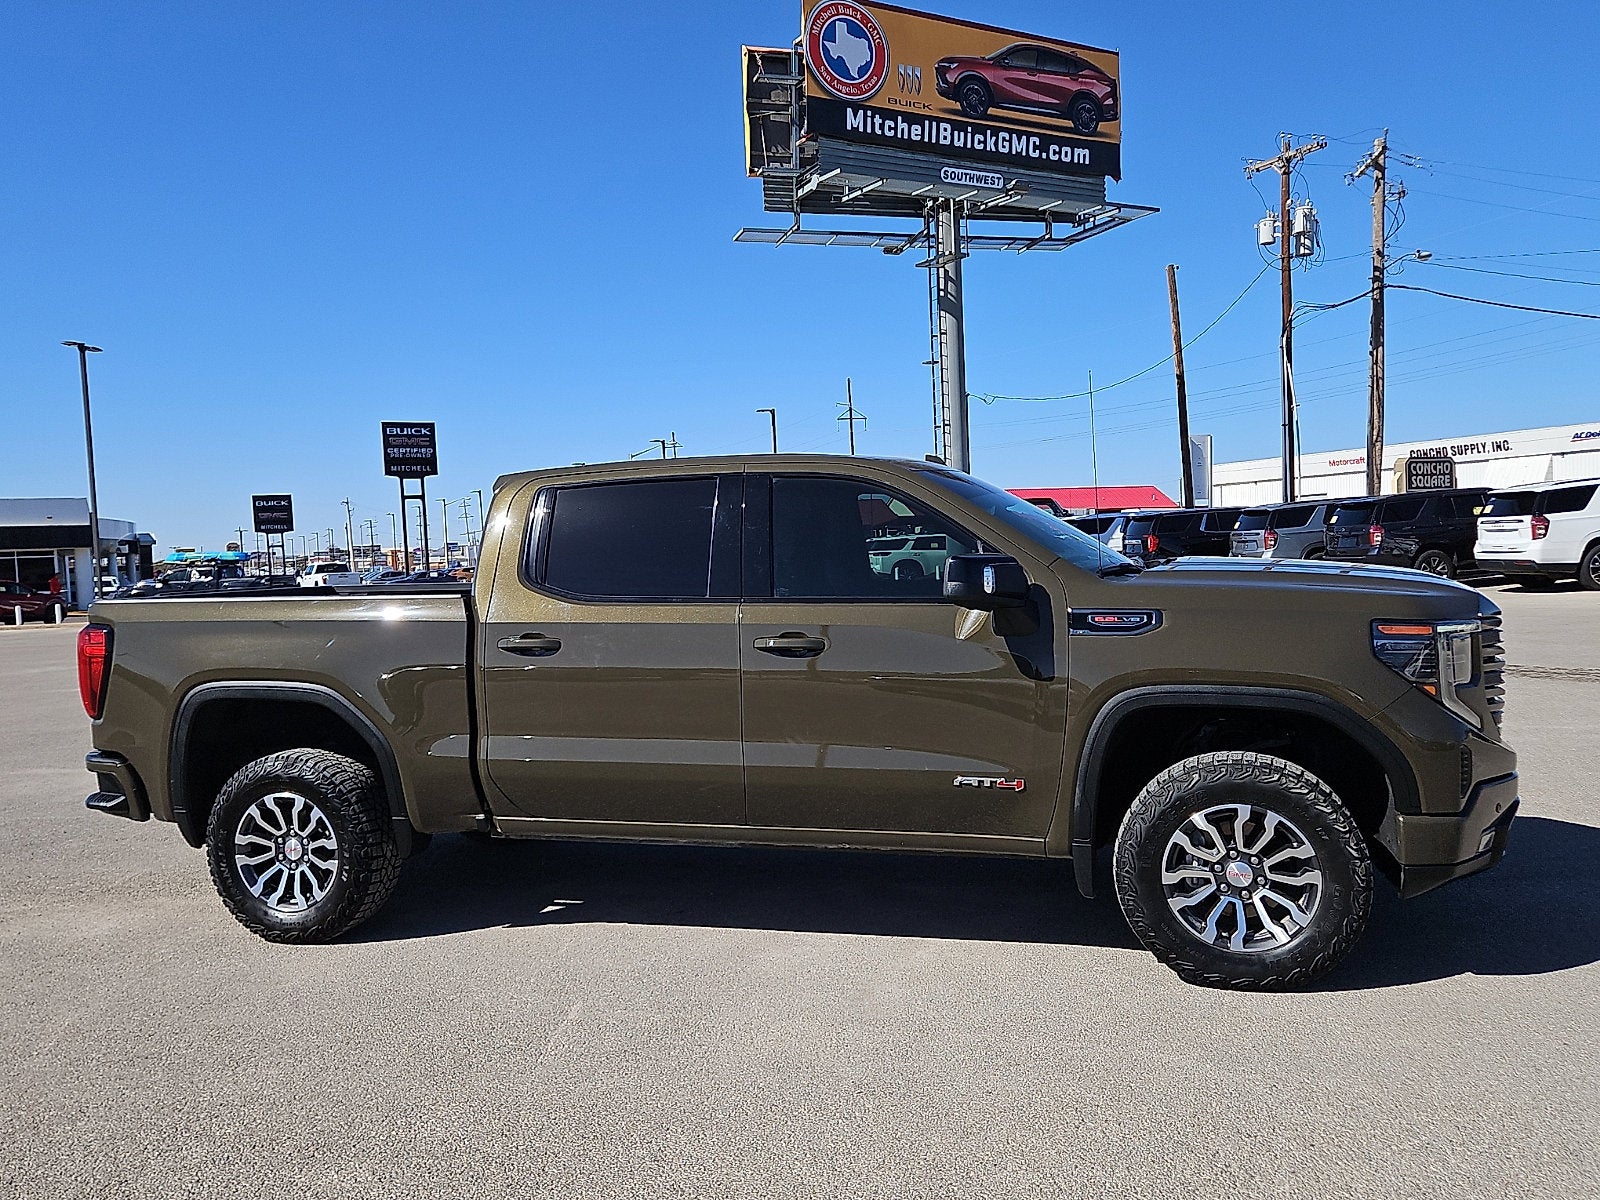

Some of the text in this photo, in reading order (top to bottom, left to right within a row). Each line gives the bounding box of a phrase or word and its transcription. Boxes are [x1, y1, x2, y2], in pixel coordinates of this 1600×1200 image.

[812, 6, 837, 36] Mitchell
[838, 5, 863, 20] Buick
[867, 22, 882, 46] GMC
[819, 65, 878, 95] San Angelo, Texas
[887, 97, 933, 111] BUICK
[846, 107, 1090, 165] MitchellBuickGMC.com
[942, 169, 1002, 187] SOUTHWEST
[386, 427, 431, 435] BUICK
[389, 437, 430, 446] GMC
[1409, 439, 1513, 458] CONCHO SUPPLY, INC.
[1328, 456, 1366, 467] Motorcraft
[1410, 462, 1451, 475] CONCHO
[1411, 475, 1451, 488] SQUARE
[953, 775, 1025, 792] AT4
[1228, 870, 1252, 880] GMC
